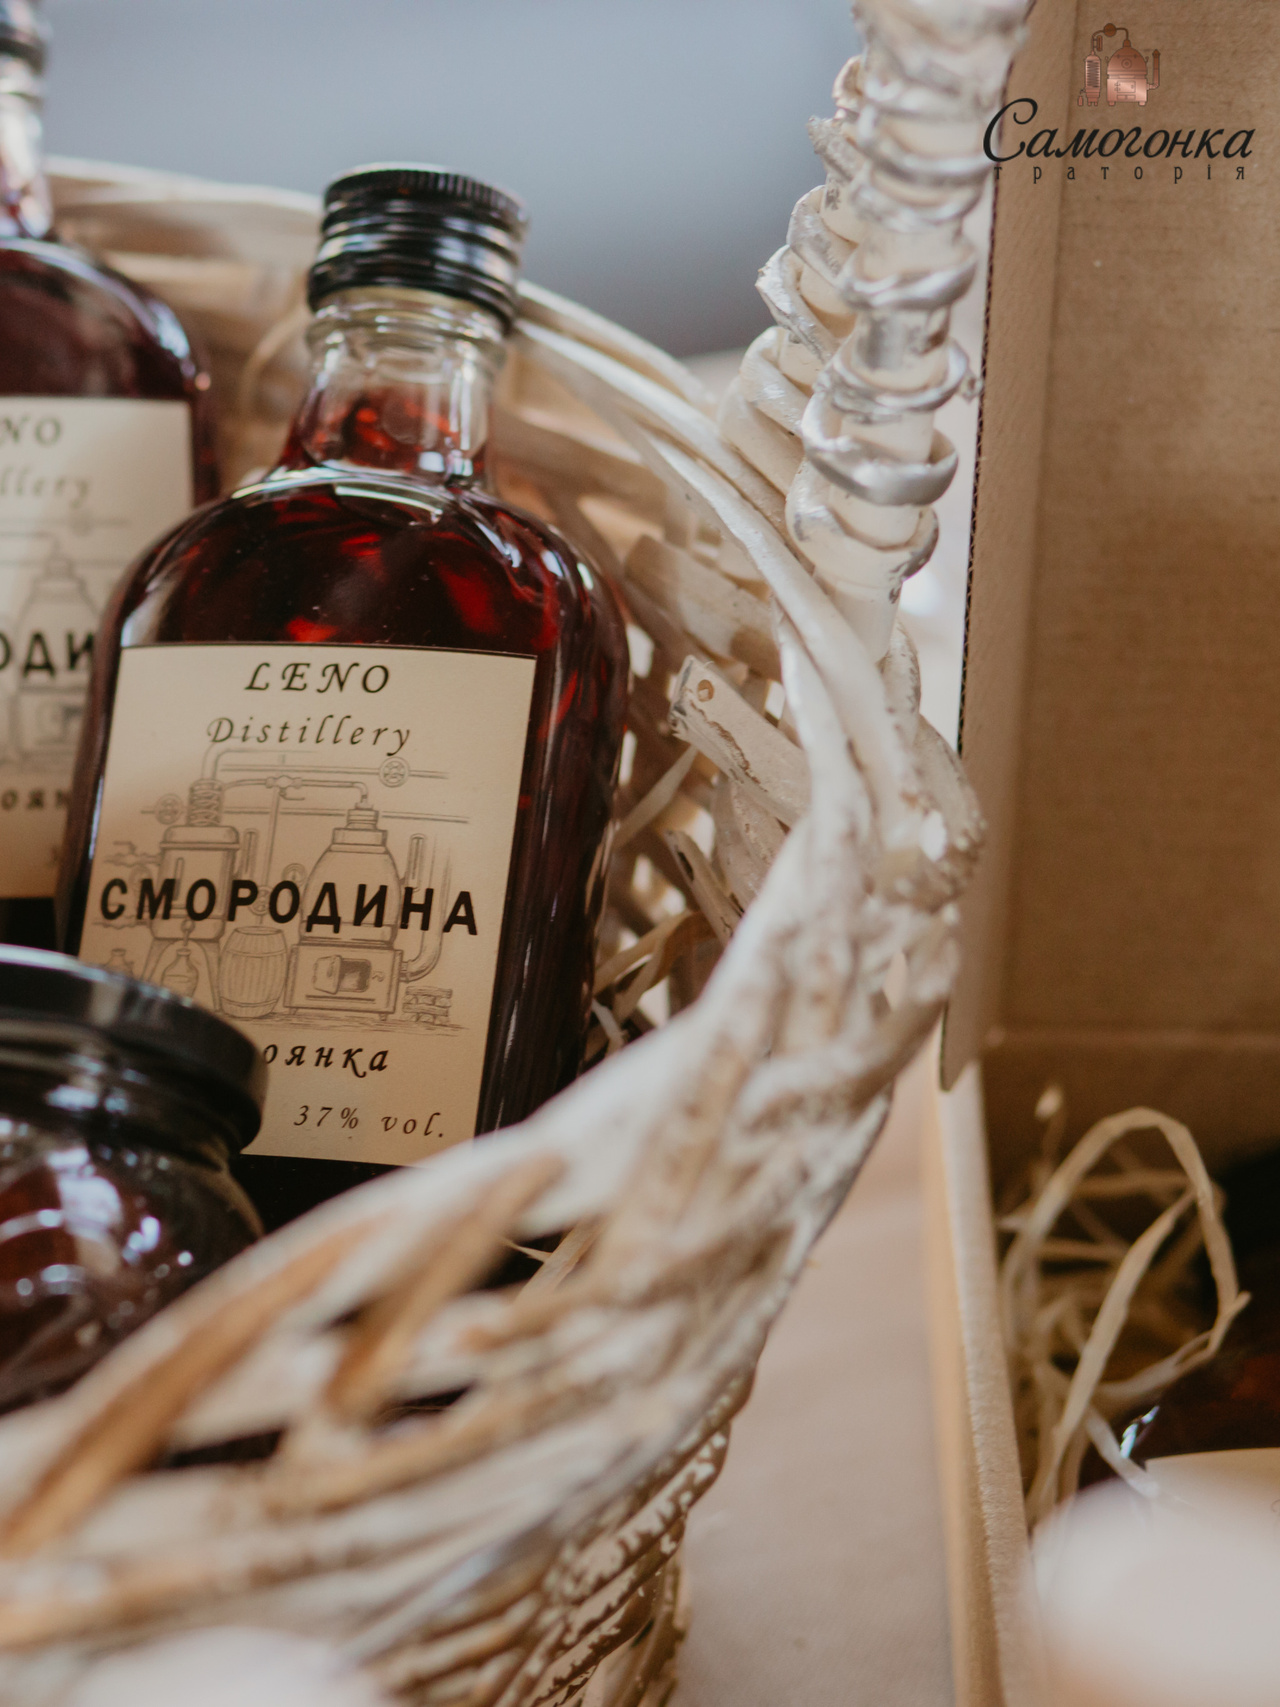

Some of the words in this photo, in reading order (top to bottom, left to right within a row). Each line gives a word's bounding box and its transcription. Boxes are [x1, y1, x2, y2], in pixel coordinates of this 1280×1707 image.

[244, 661, 391, 694] LENO
[206, 714, 411, 756] Distillery
[99, 878, 479, 936] СМОРОДИНА
[293, 1105, 359, 1130] 37%
[381, 1112, 444, 1138] vol.
